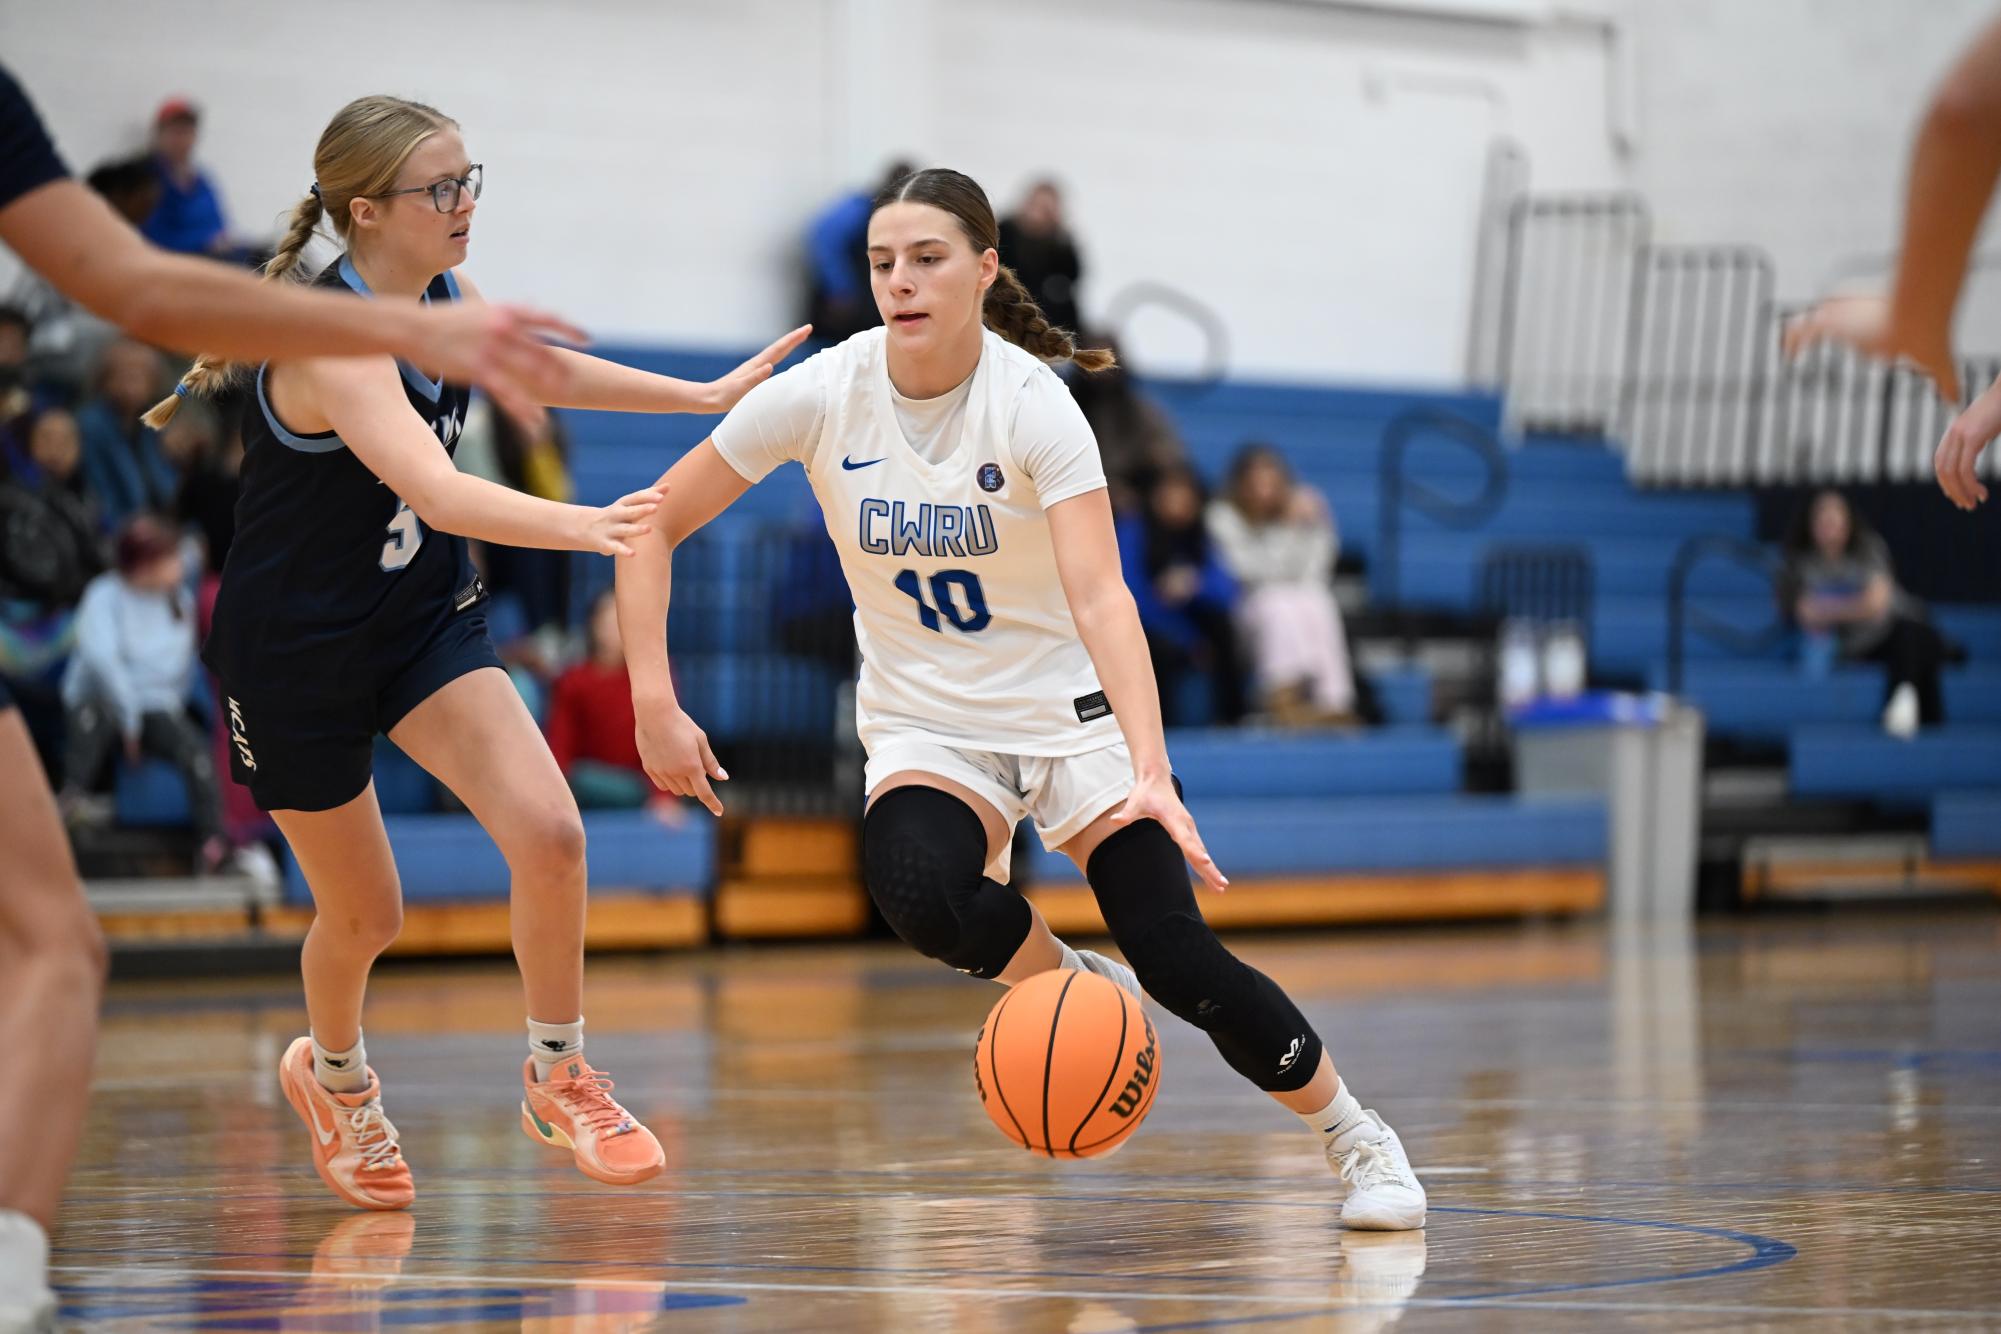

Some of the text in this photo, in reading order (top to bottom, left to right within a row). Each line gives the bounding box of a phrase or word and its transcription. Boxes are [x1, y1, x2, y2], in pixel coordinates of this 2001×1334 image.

[378, 496, 424, 573] 5
[859, 497, 999, 558] CWRU
[892, 567, 994, 634] 10
[1108, 1008, 1156, 1119] Wilso
